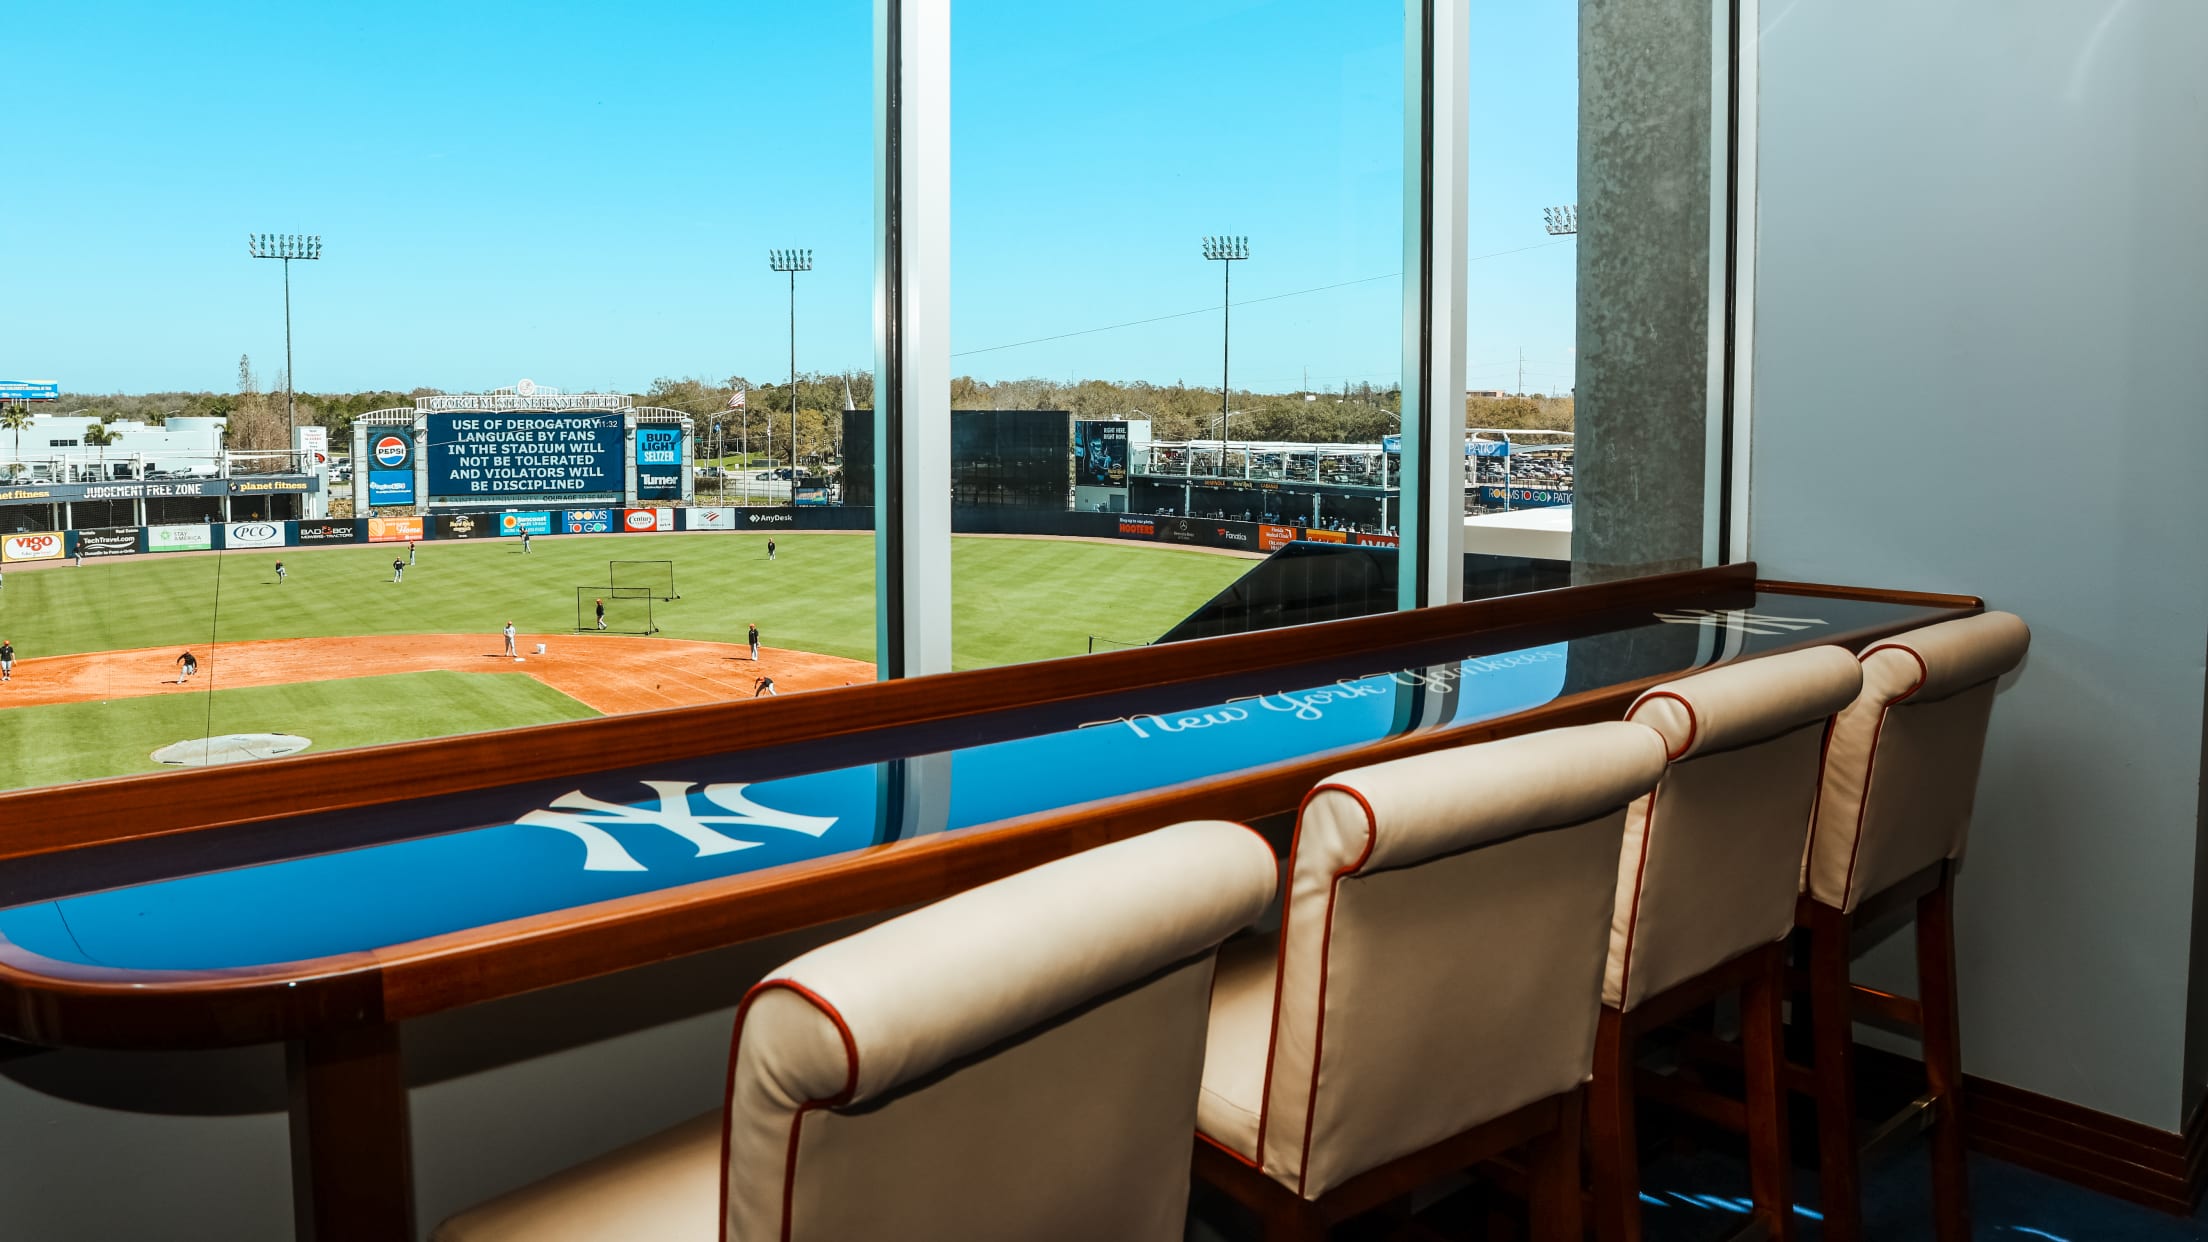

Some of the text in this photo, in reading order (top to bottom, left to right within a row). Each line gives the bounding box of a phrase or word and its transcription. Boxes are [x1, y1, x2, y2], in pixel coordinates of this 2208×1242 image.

[431, 397, 477, 410] GEORGE
[497, 396, 584, 409] STEINBRENNER
[452, 418, 600, 430] USE OF DEROGATORY
[458, 431, 596, 442] LANGUAGE BY FANS
[646, 434, 672, 442] BUD
[448, 443, 605, 455] IN THE STADIUM WILL
[642, 442, 676, 451] LIGHT
[1468, 443, 1496, 454] PATIO
[460, 455, 594, 467] NOT BE TOLERATED
[644, 451, 674, 462] SELTZER
[450, 467, 604, 480] AND VIOLATORS WILL
[471, 479, 585, 491] BE DISCIPLINED
[641, 474, 678, 485] Turner
[84, 484, 202, 498] JUDGEMENT FREE ZONE
[240, 482, 307, 492] planet fitness
[14, 490, 50, 498] fitness
[1521, 490, 1531, 500] TO
[1532, 491, 1546, 502] GO
[568, 510, 607, 520] ROOMS
[240, 526, 268, 536] PCC
[568, 523, 581, 532] TO
[584, 522, 600, 532] GO
[1120, 524, 1154, 534] HOOTERS
[1226, 530, 1247, 540] Fanatics
[16, 537, 52, 551] vigo
[1079, 650, 1558, 738] New York Yankees
